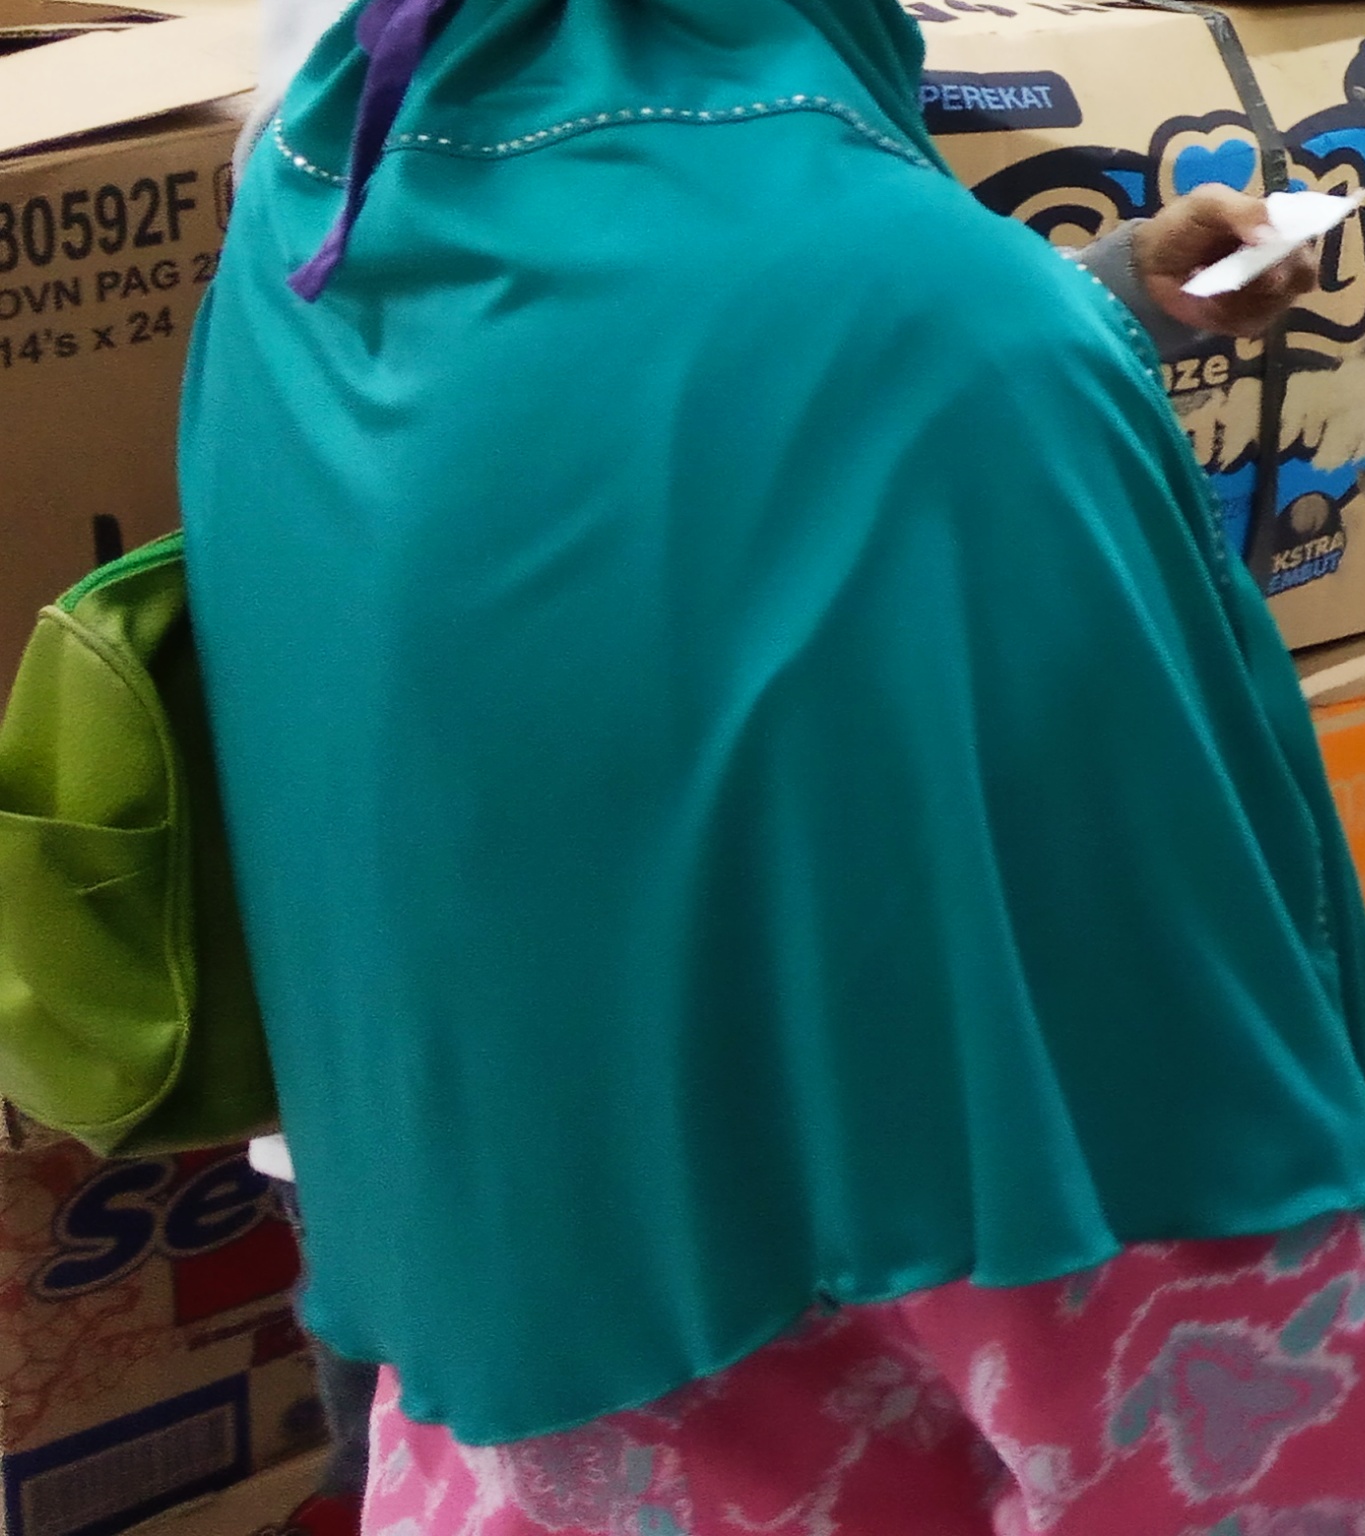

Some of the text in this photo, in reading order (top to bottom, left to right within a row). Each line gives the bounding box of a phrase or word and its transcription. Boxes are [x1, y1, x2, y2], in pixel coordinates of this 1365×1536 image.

[920, 84, 1052, 112] PEREKAT
[95, 259, 181, 303] PAG
[126, 305, 175, 344] 24
[1271, 531, 1346, 573] KSTRA
